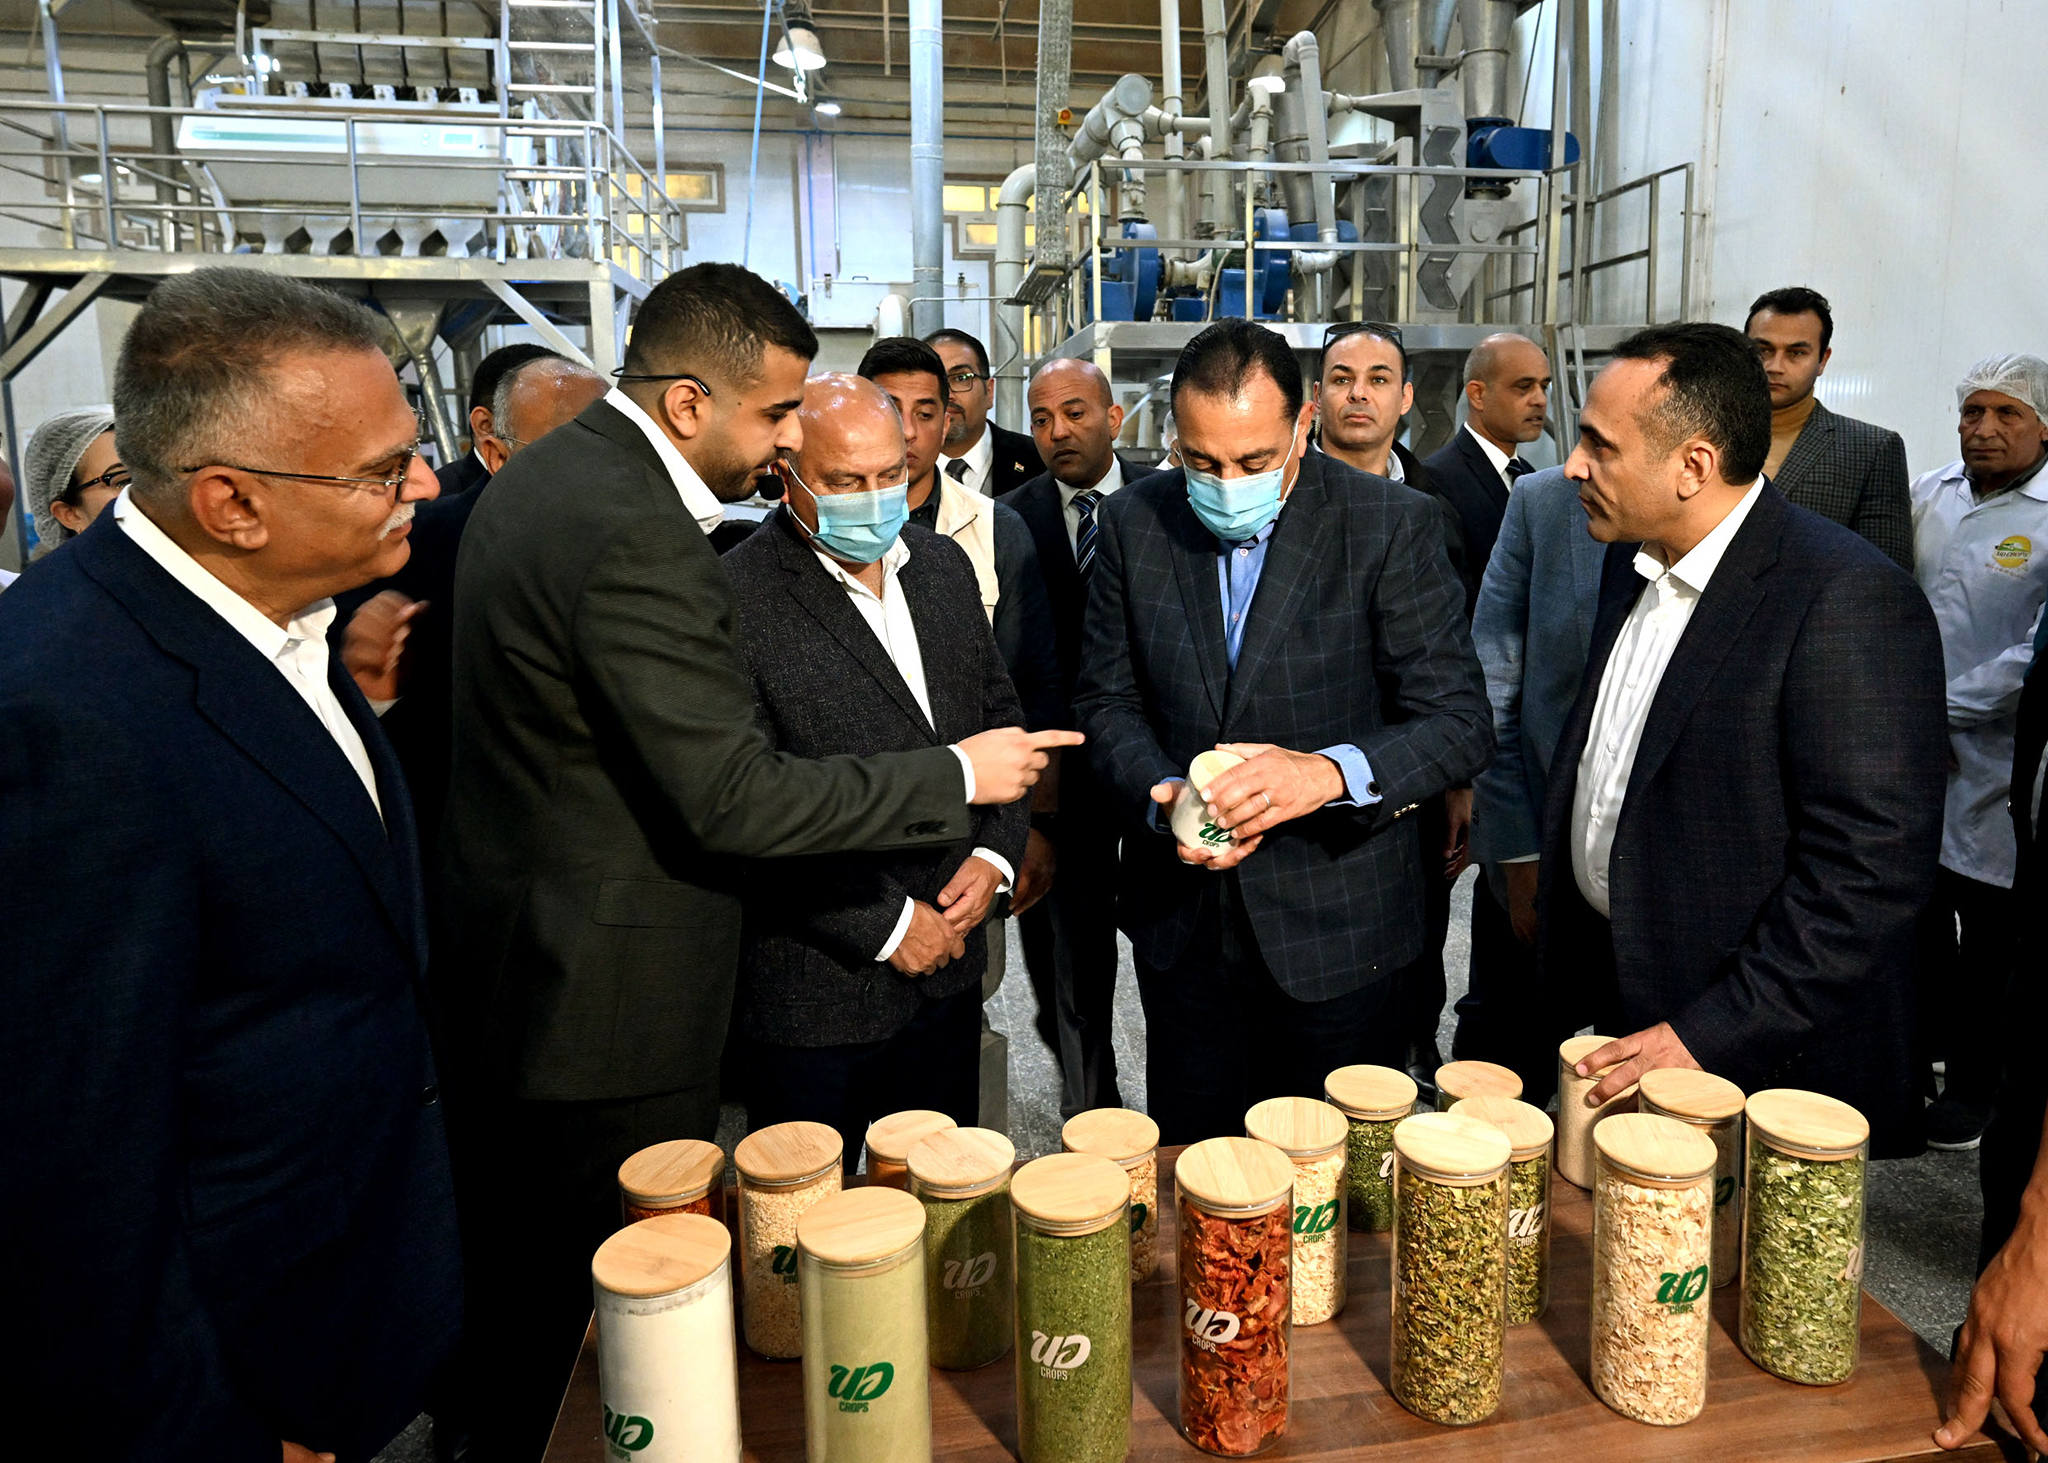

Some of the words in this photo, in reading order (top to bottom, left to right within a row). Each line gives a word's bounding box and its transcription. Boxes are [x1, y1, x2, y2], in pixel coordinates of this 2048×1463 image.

[1302, 1233, 1326, 1244] CROPS
[1516, 1234, 1538, 1248] CROPS
[1669, 1302, 1694, 1315] CROPS
[1192, 1334, 1216, 1353] CROPS
[1040, 1366, 1068, 1381] CROPS
[839, 1401, 869, 1413] CROPS
